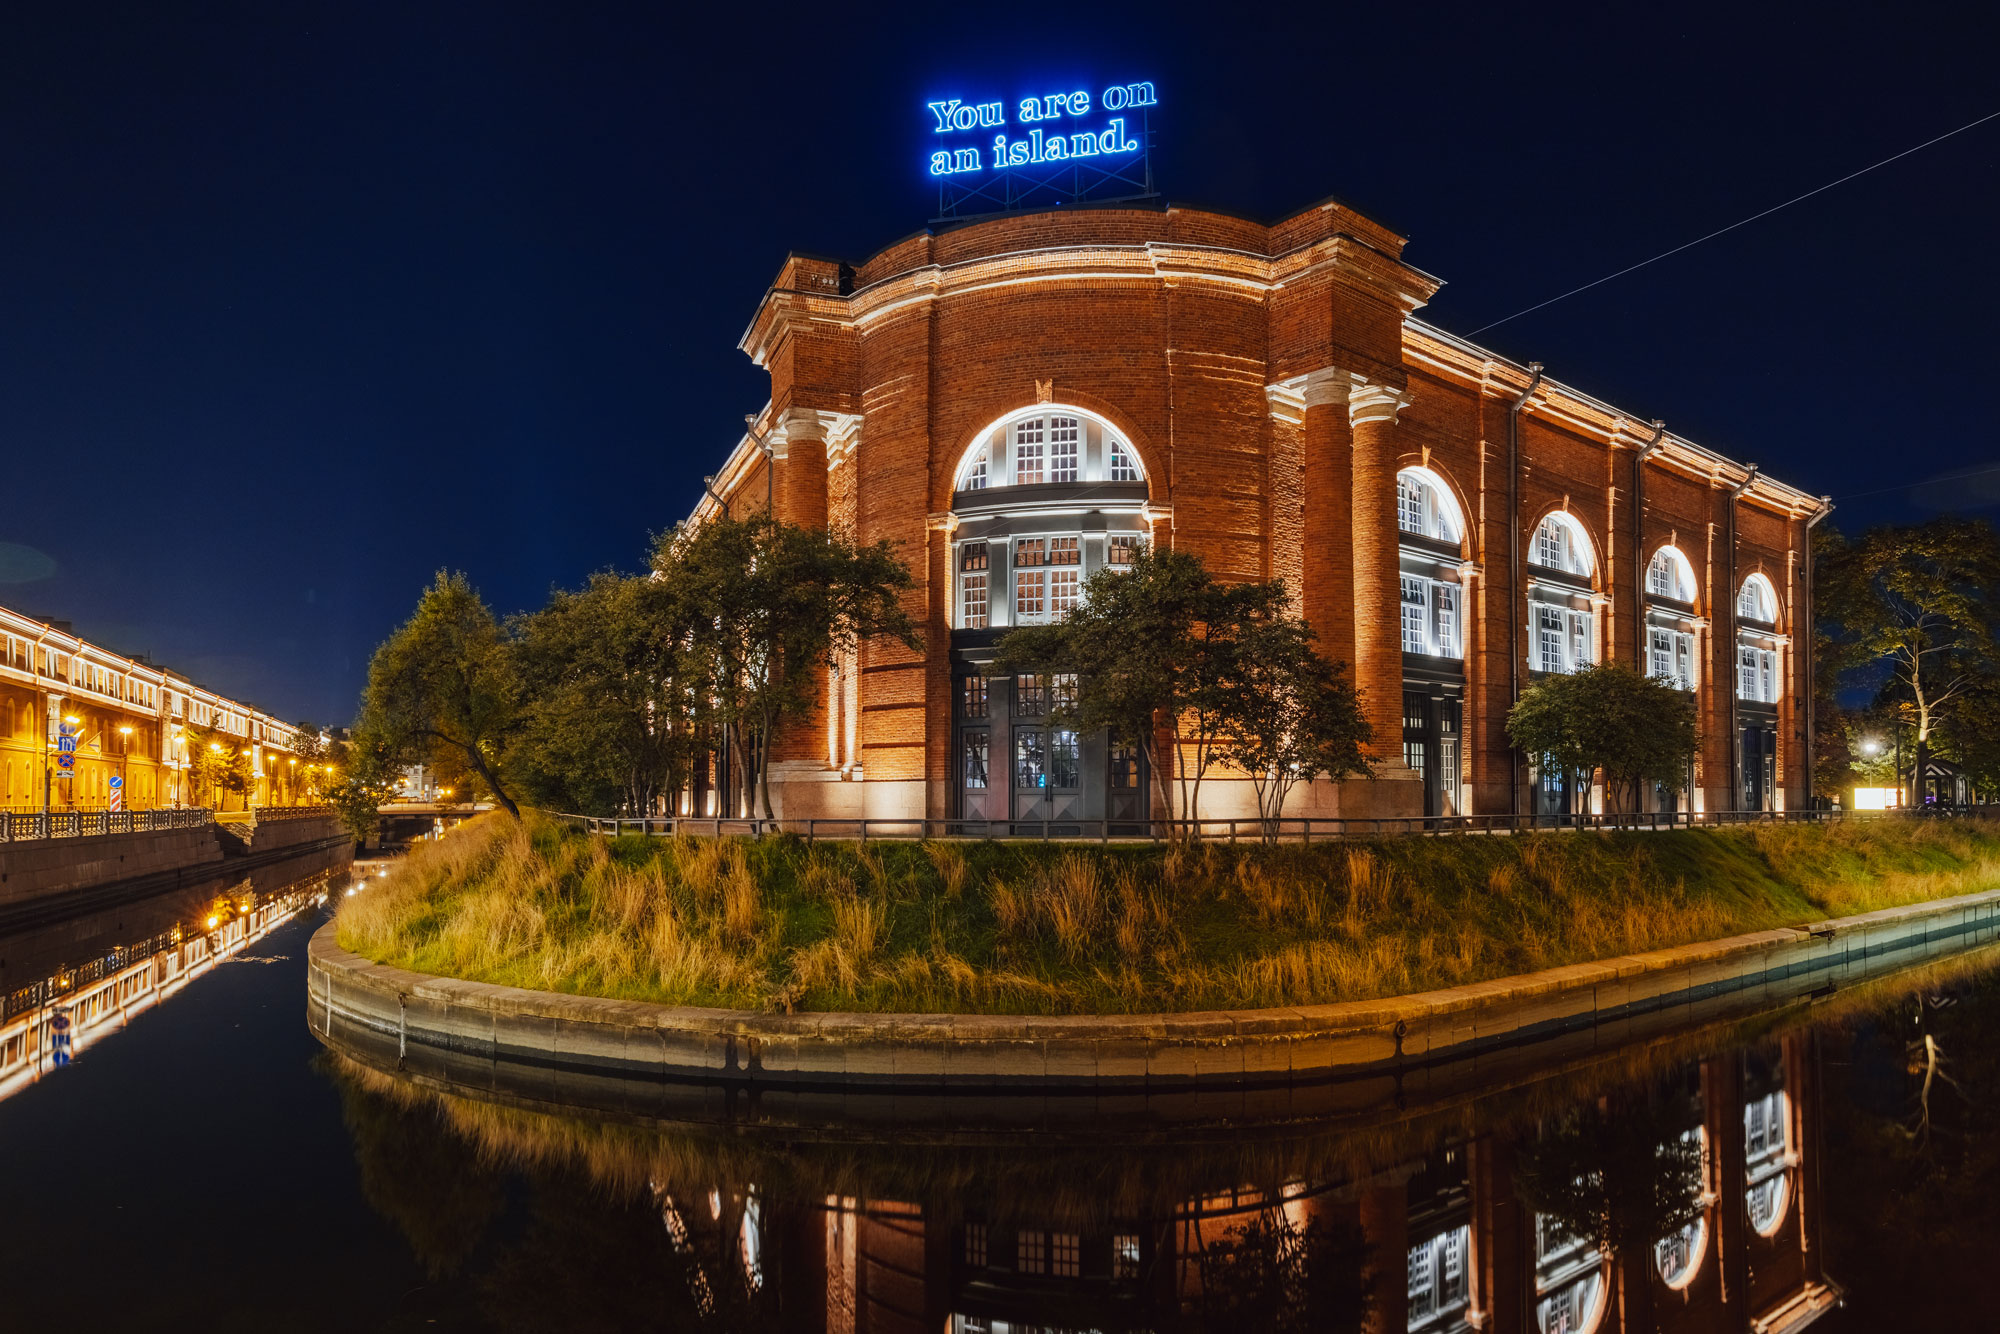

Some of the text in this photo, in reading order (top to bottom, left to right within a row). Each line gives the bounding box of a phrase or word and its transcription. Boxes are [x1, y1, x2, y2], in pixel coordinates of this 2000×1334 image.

[928, 80, 1157, 132] You are on
[930, 118, 1138, 175] an island.
